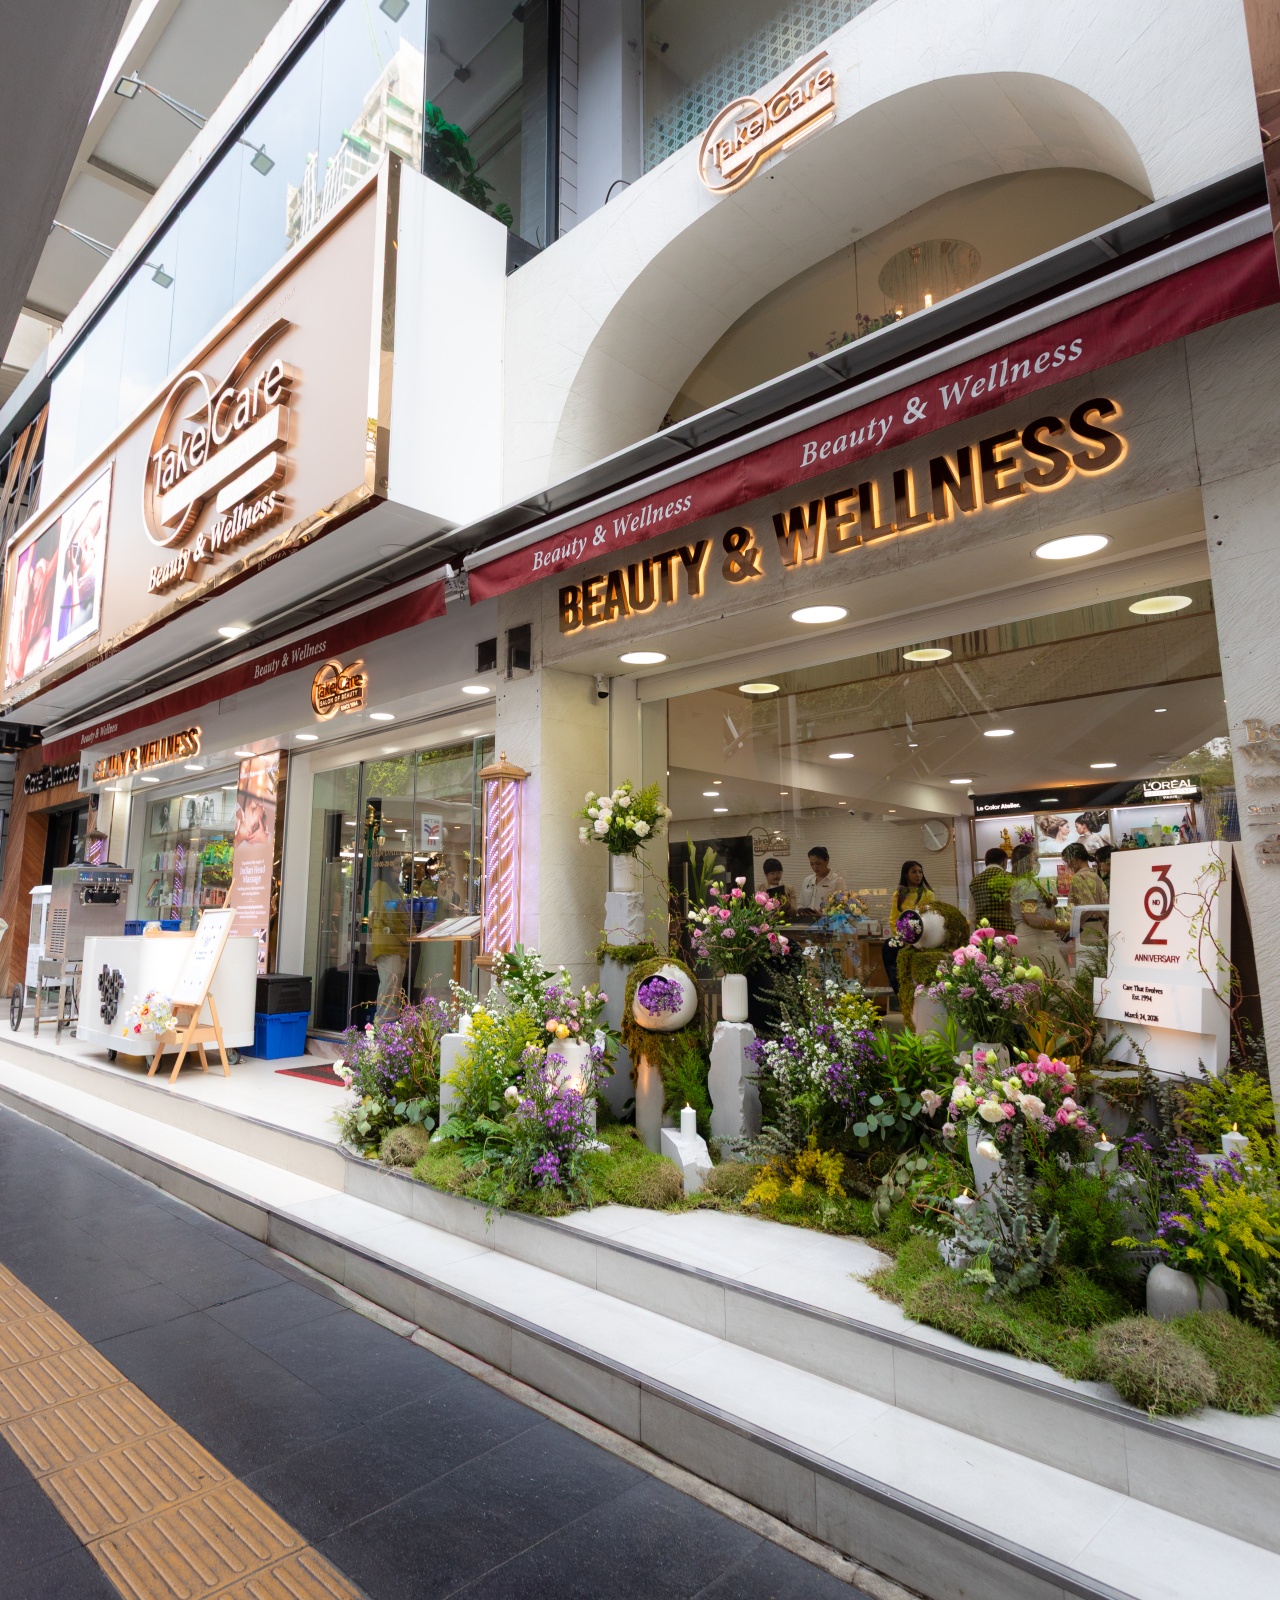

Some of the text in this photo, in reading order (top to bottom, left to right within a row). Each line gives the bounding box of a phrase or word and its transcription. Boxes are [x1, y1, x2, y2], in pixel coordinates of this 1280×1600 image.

[708, 117, 764, 168] Take
[769, 67, 834, 122] Care
[800, 338, 1083, 468] Beauty & Wellness
[152, 425, 207, 497] Take
[212, 358, 285, 446] Care
[558, 398, 1127, 634] BEAUTY & WELLNESS
[147, 490, 277, 594] Beauty & Wellness
[532, 495, 692, 572] Beauty & Wellness
[253, 640, 327, 679] Beauty & Wellness
[315, 674, 364, 700] Take Care
[80, 732, 96, 744] Beauty
[100, 723, 119, 737] Wellness
[140, 728, 200, 768] WELLNESS
[242, 875, 262, 885] Massage
[254, 864, 266, 874] Head
[1134, 953, 1181, 964] ANNIVERSARY
[1133, 984, 1144, 993] That
[1145, 986, 1164, 995] Evolves
[1141, 994, 1152, 1003] 1994
[1124, 1011, 1139, 1020] March
